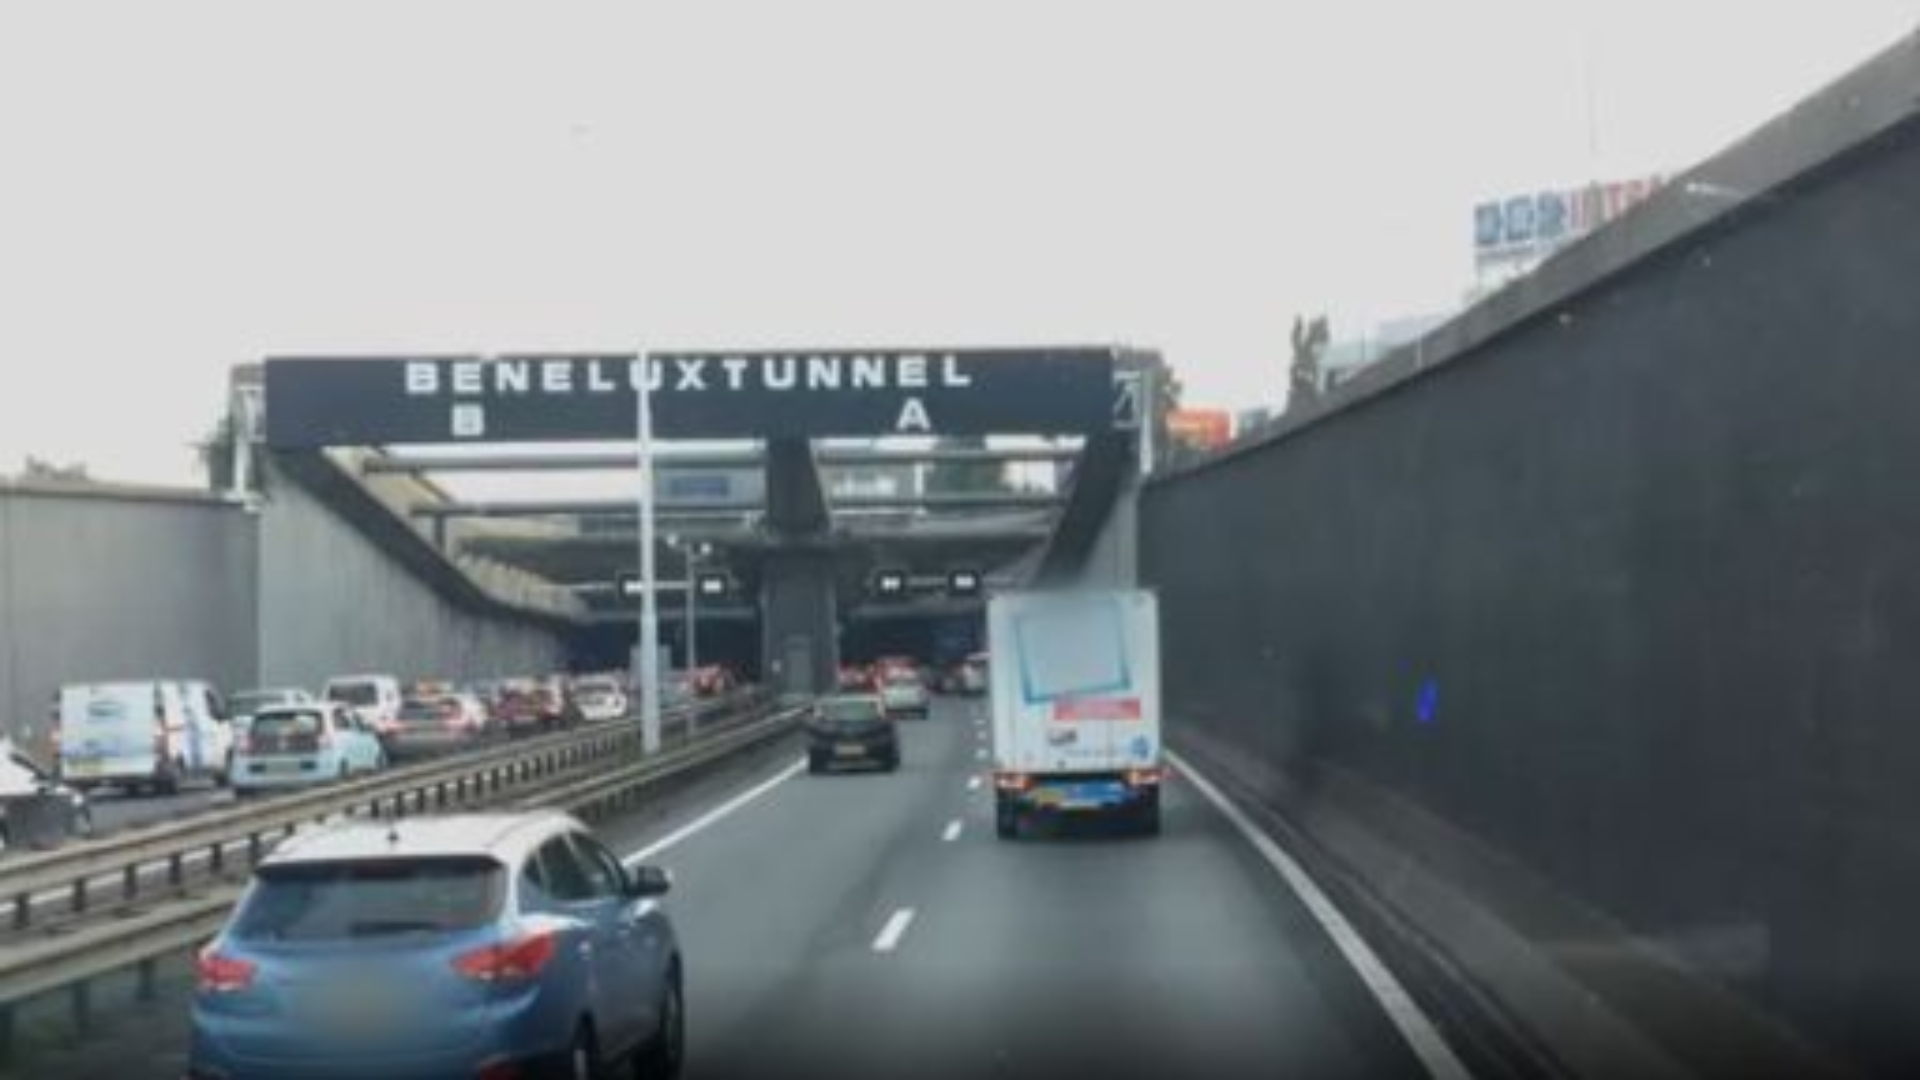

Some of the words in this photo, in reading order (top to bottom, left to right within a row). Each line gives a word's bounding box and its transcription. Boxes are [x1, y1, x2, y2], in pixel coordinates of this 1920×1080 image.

[405, 356, 972, 393] BENELUXTUNNEL
[452, 404, 485, 436] B
[897, 398, 932, 431] A
